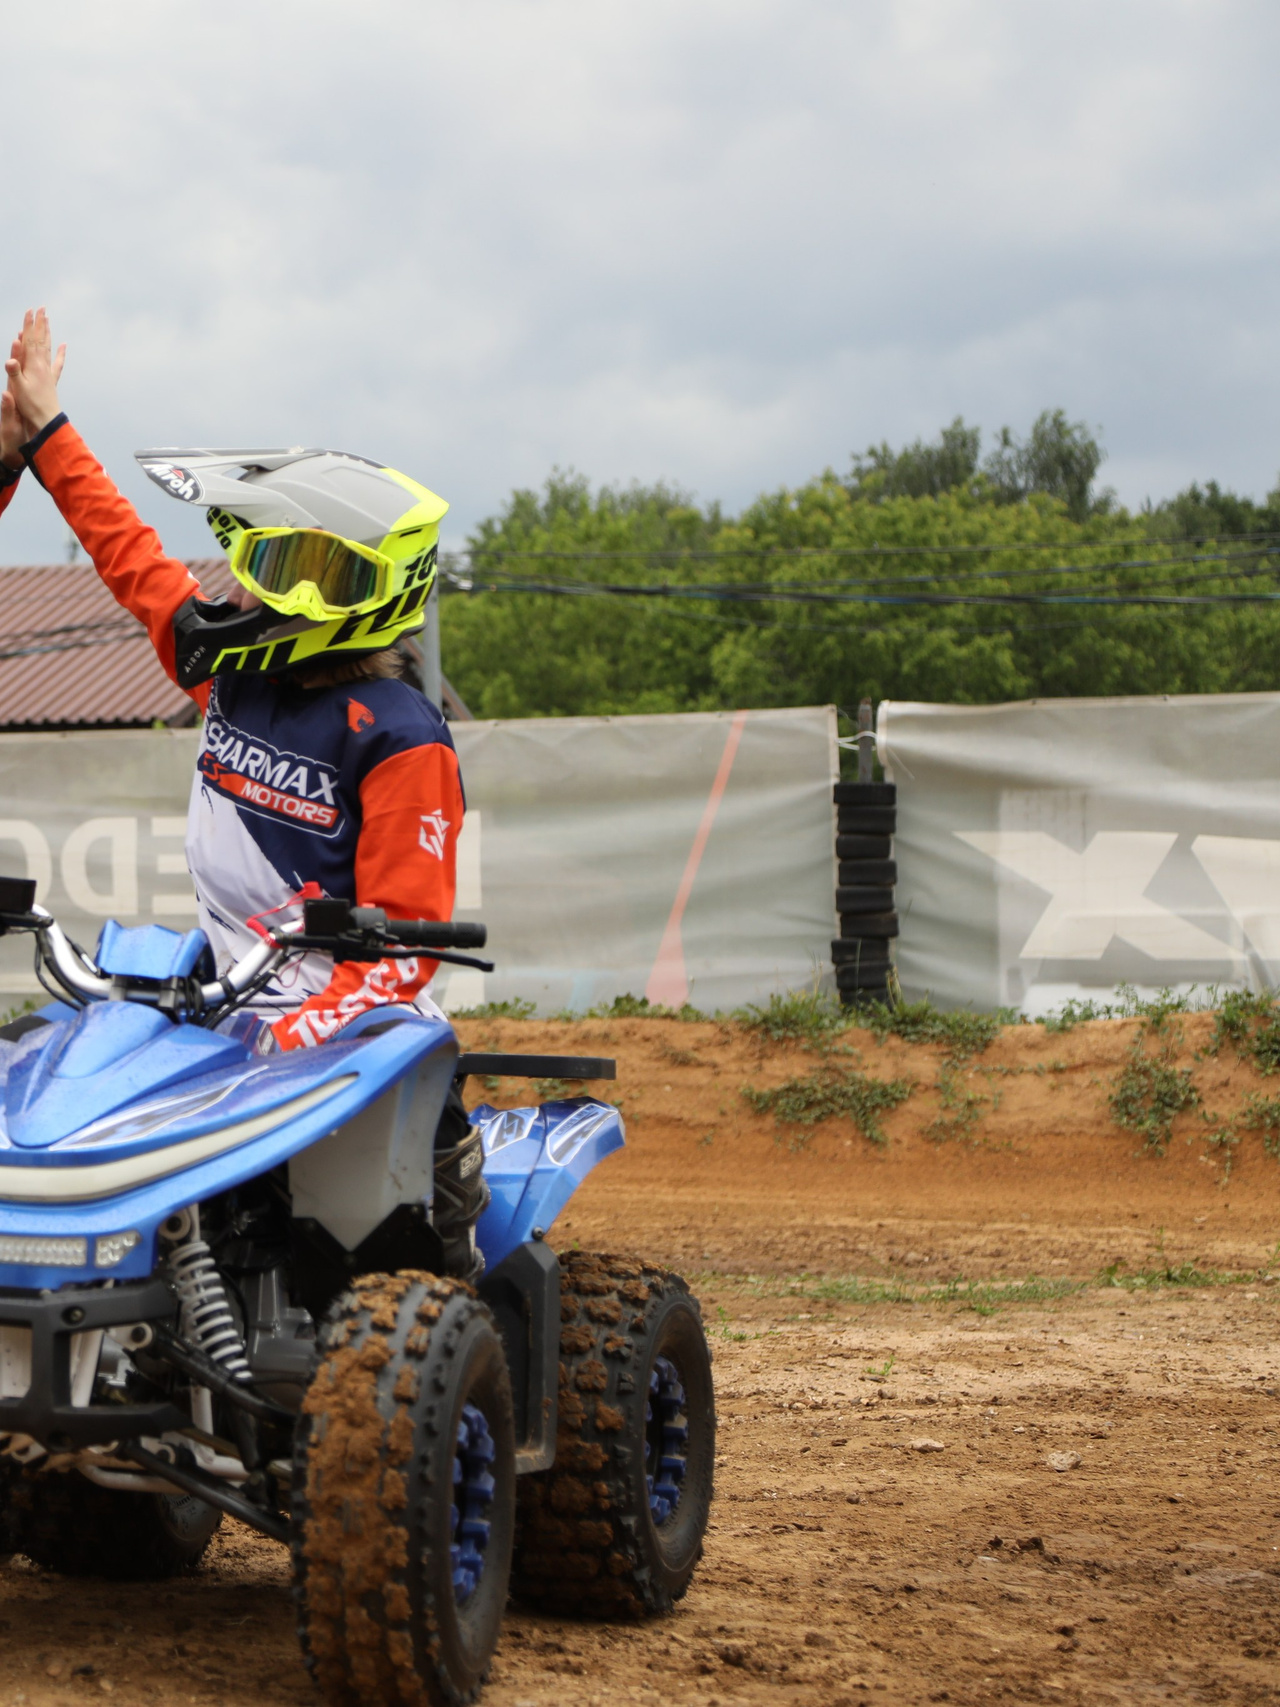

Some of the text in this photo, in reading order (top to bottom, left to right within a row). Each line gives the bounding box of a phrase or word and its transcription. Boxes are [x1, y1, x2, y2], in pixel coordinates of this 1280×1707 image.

[142, 462, 195, 500] Airoh
[183, 645, 207, 674] AIROH
[205, 721, 339, 806] SHARMAX
[240, 780, 335, 826] MOTORS
